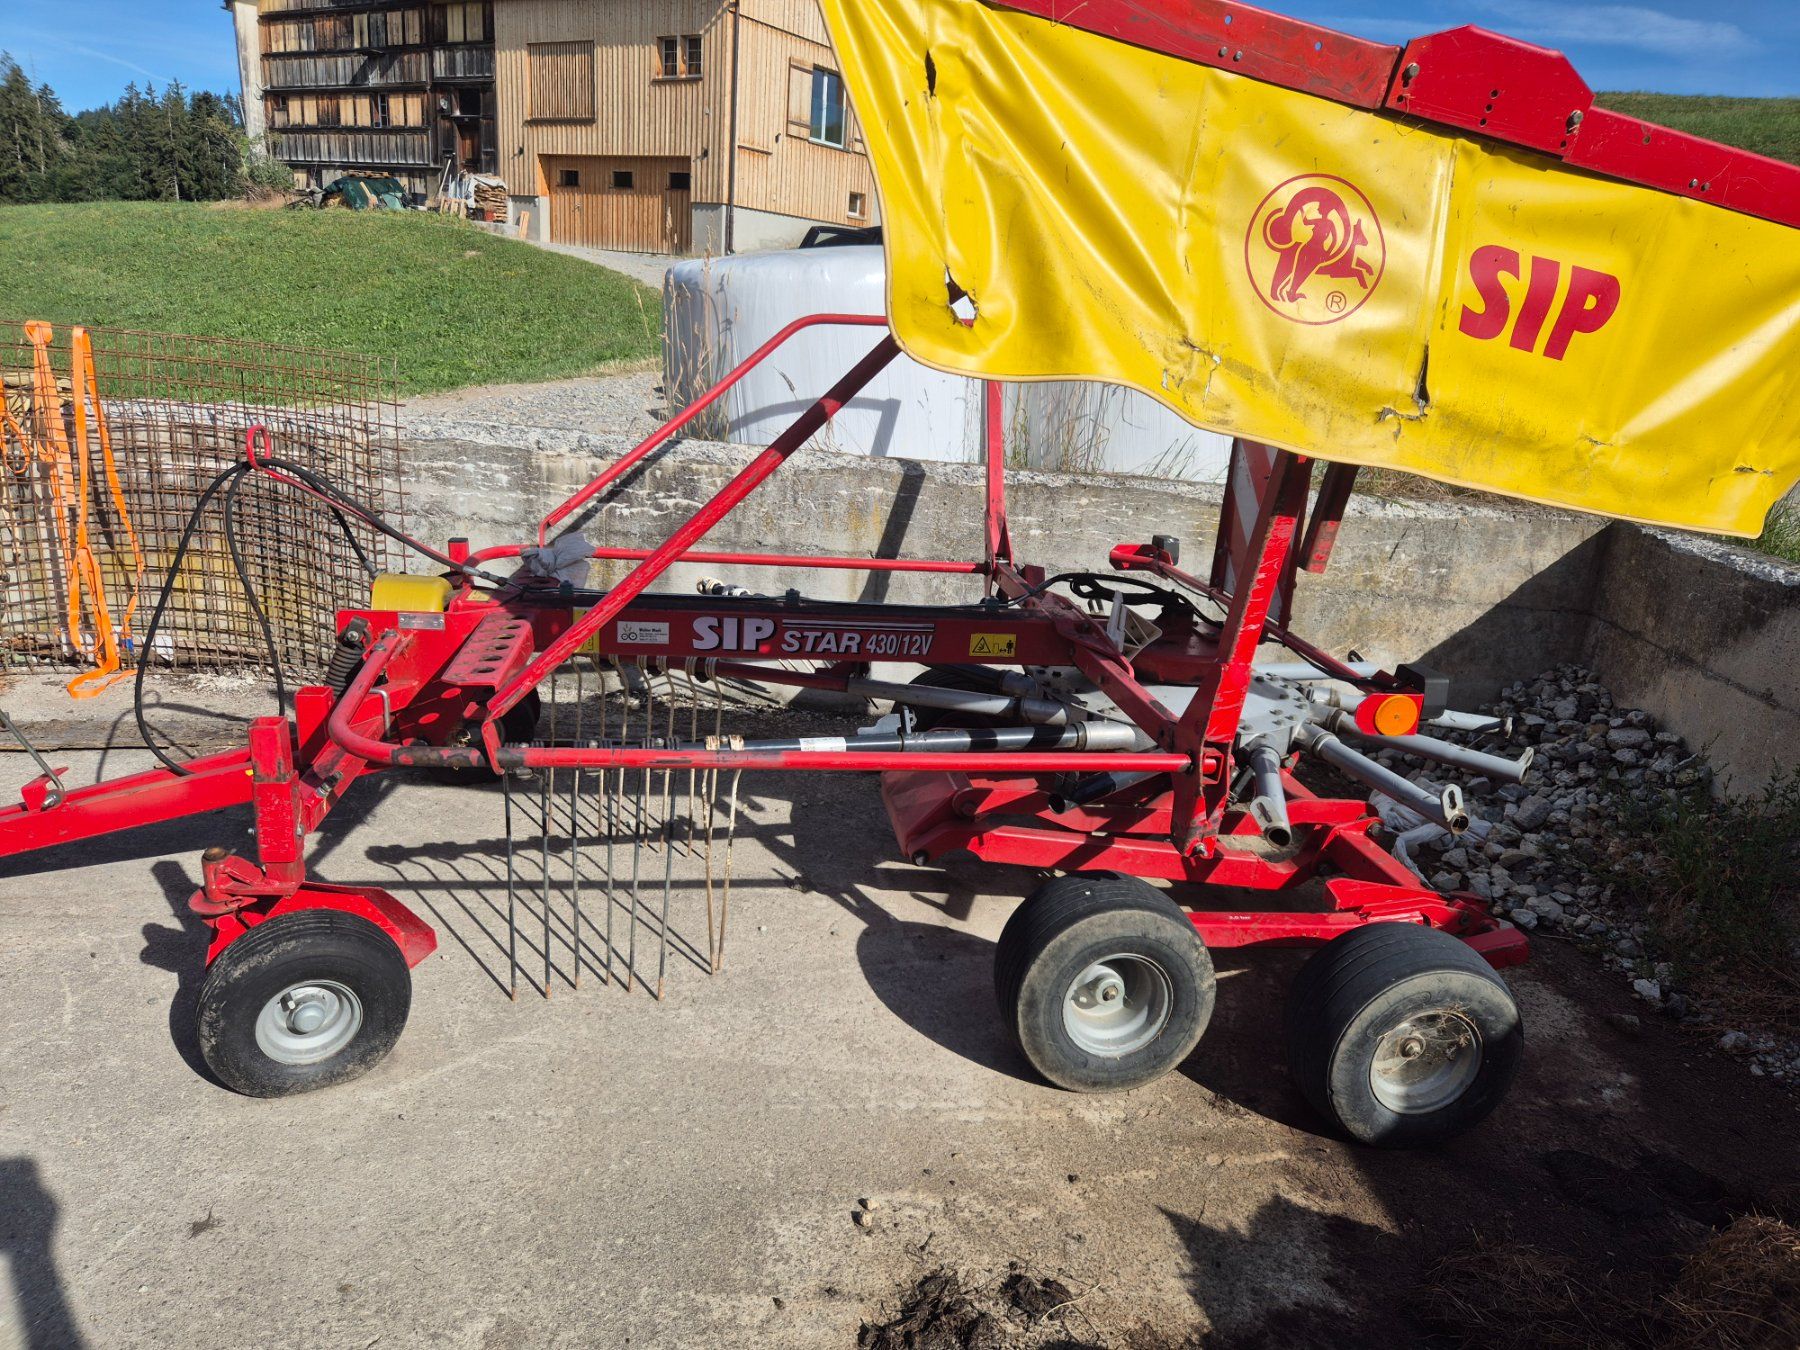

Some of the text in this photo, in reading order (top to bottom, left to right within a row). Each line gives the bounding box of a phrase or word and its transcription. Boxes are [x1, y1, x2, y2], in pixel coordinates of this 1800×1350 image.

[1458, 244, 1621, 361] SIP
[692, 616, 934, 656] SIP STAR 430/12V
